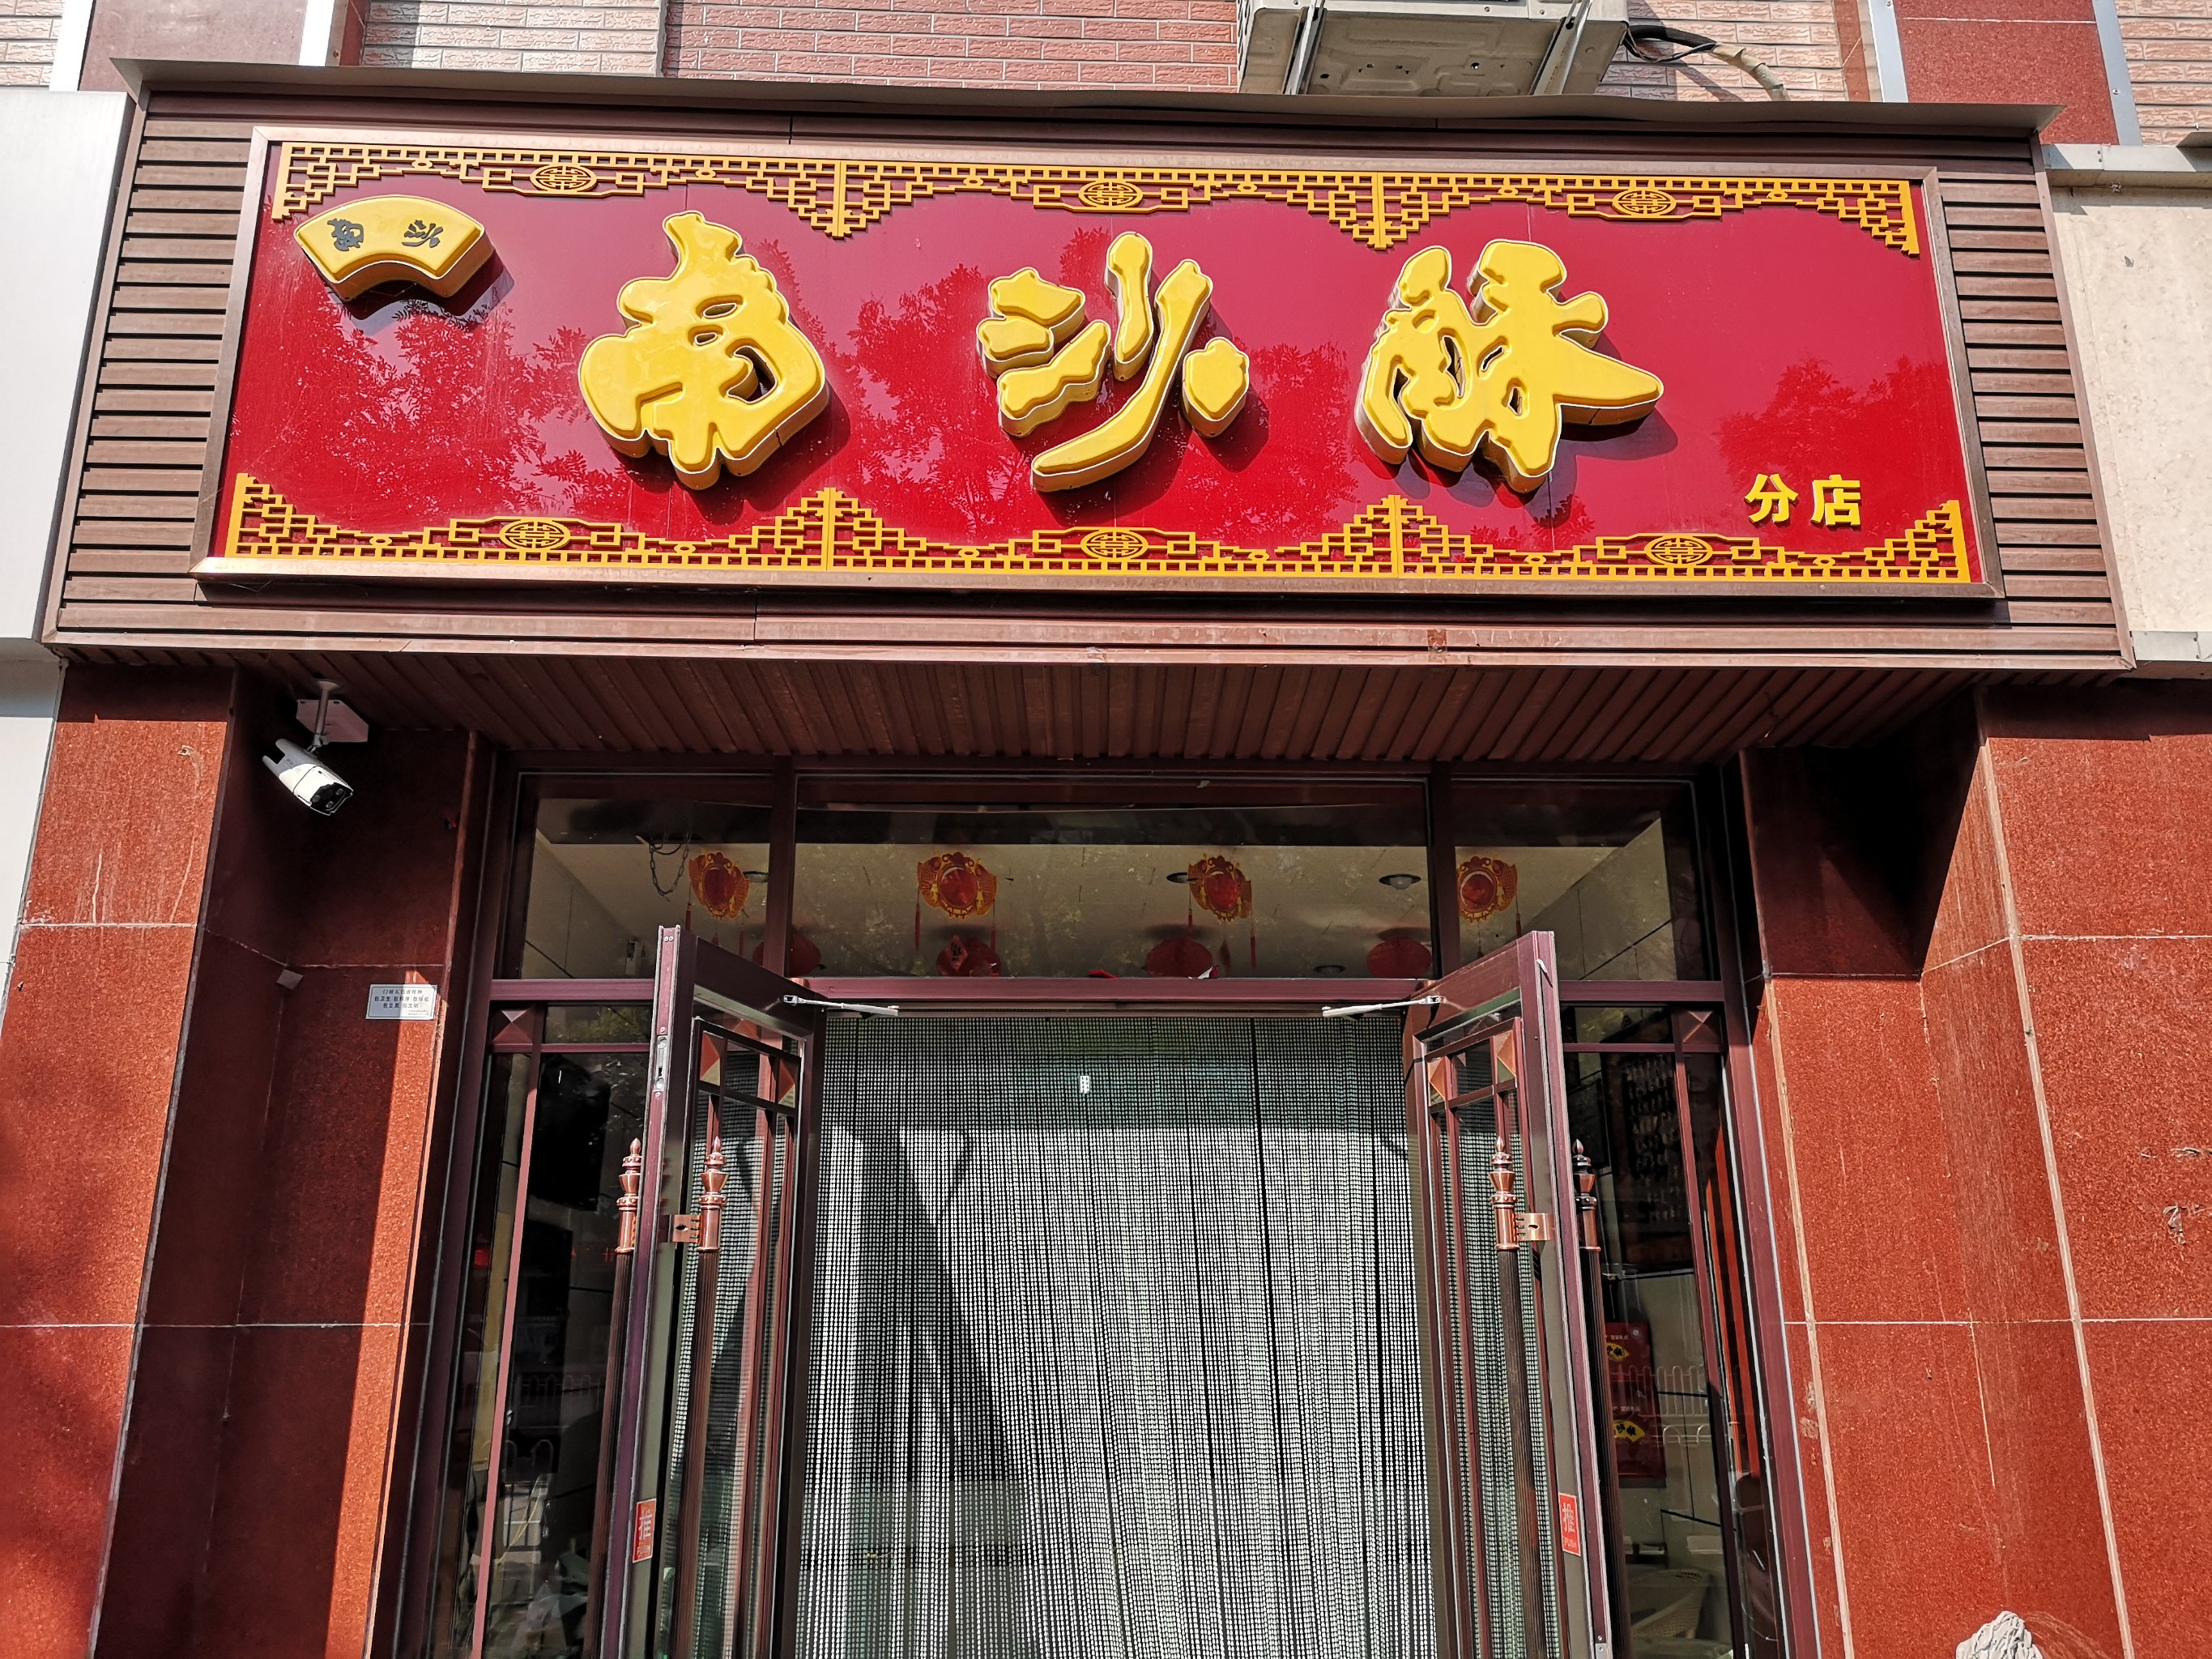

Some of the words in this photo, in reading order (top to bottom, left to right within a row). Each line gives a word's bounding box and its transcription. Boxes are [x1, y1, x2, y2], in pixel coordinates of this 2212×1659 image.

[1745, 473, 1861, 527] 分店
[638, 1507, 653, 1541] 推
[1562, 1502, 1575, 1533] 推
